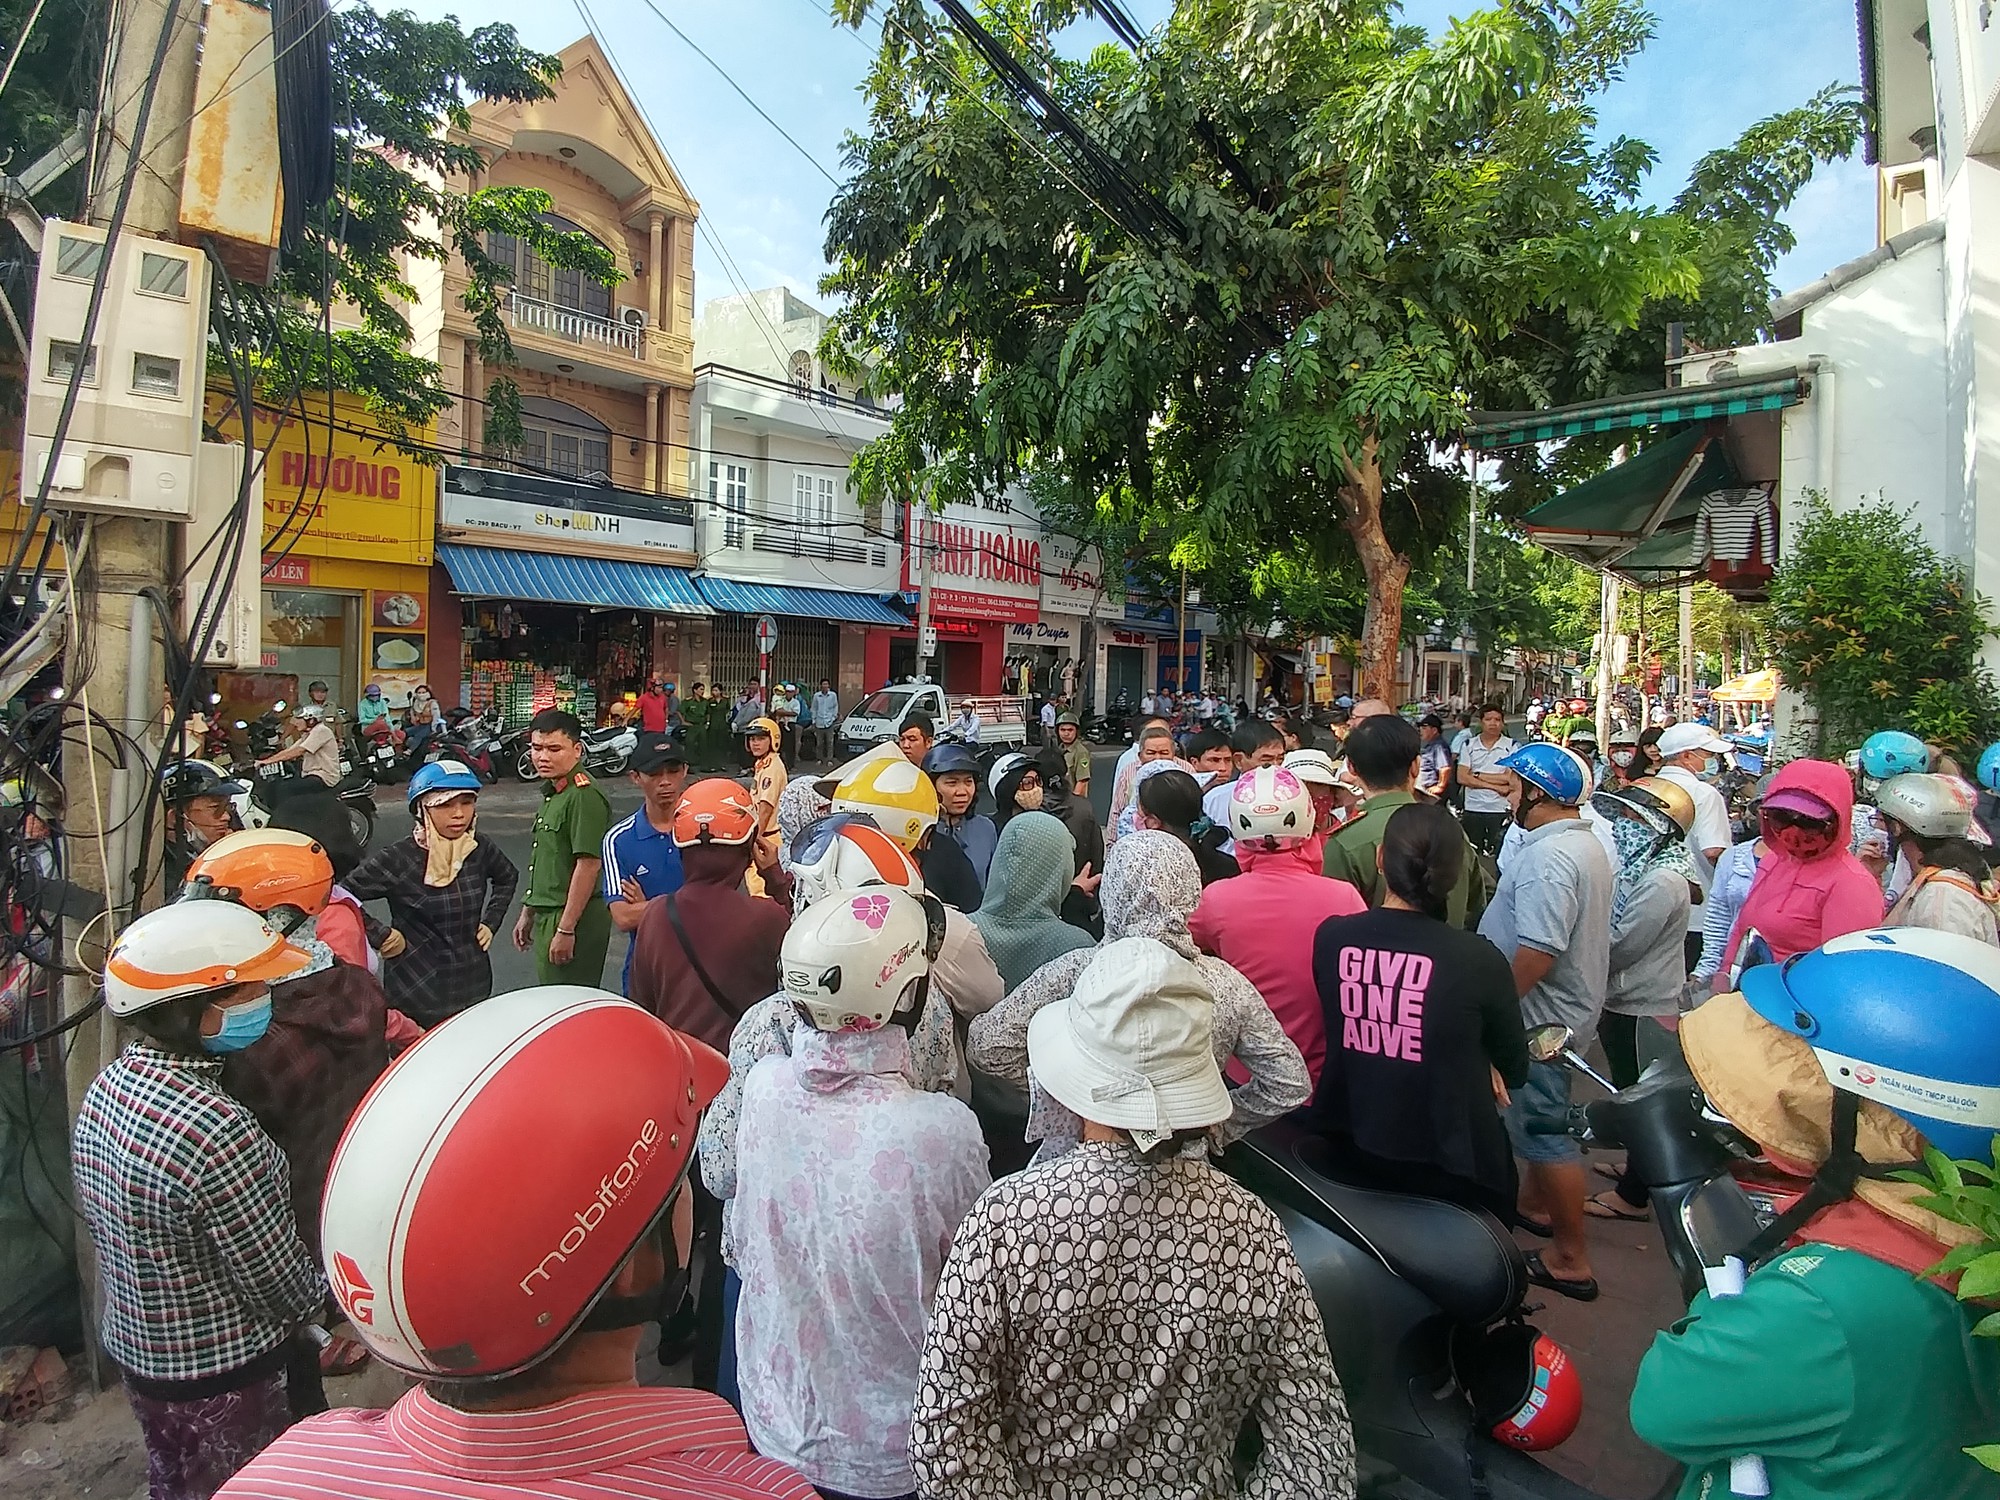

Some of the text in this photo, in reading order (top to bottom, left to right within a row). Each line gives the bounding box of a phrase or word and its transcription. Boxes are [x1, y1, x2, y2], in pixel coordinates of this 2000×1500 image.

[281, 450, 401, 500] HƯƠNG
[534, 511, 620, 534] Shop MINH
[281, 562, 304, 579] LÊN
[979, 524, 1040, 586] HOÀNG
[1037, 622, 1070, 643] Duyên
[850, 724, 877, 733] POLICE
[1338, 946, 1433, 992] GIVD
[1339, 981, 1425, 1029] ONE
[1343, 1016, 1422, 1063] ADVE
[1902, 1083, 1923, 1096] HÀNG
[1925, 1090, 1945, 1101] TMCP
[519, 1118, 658, 1296] mobifone
